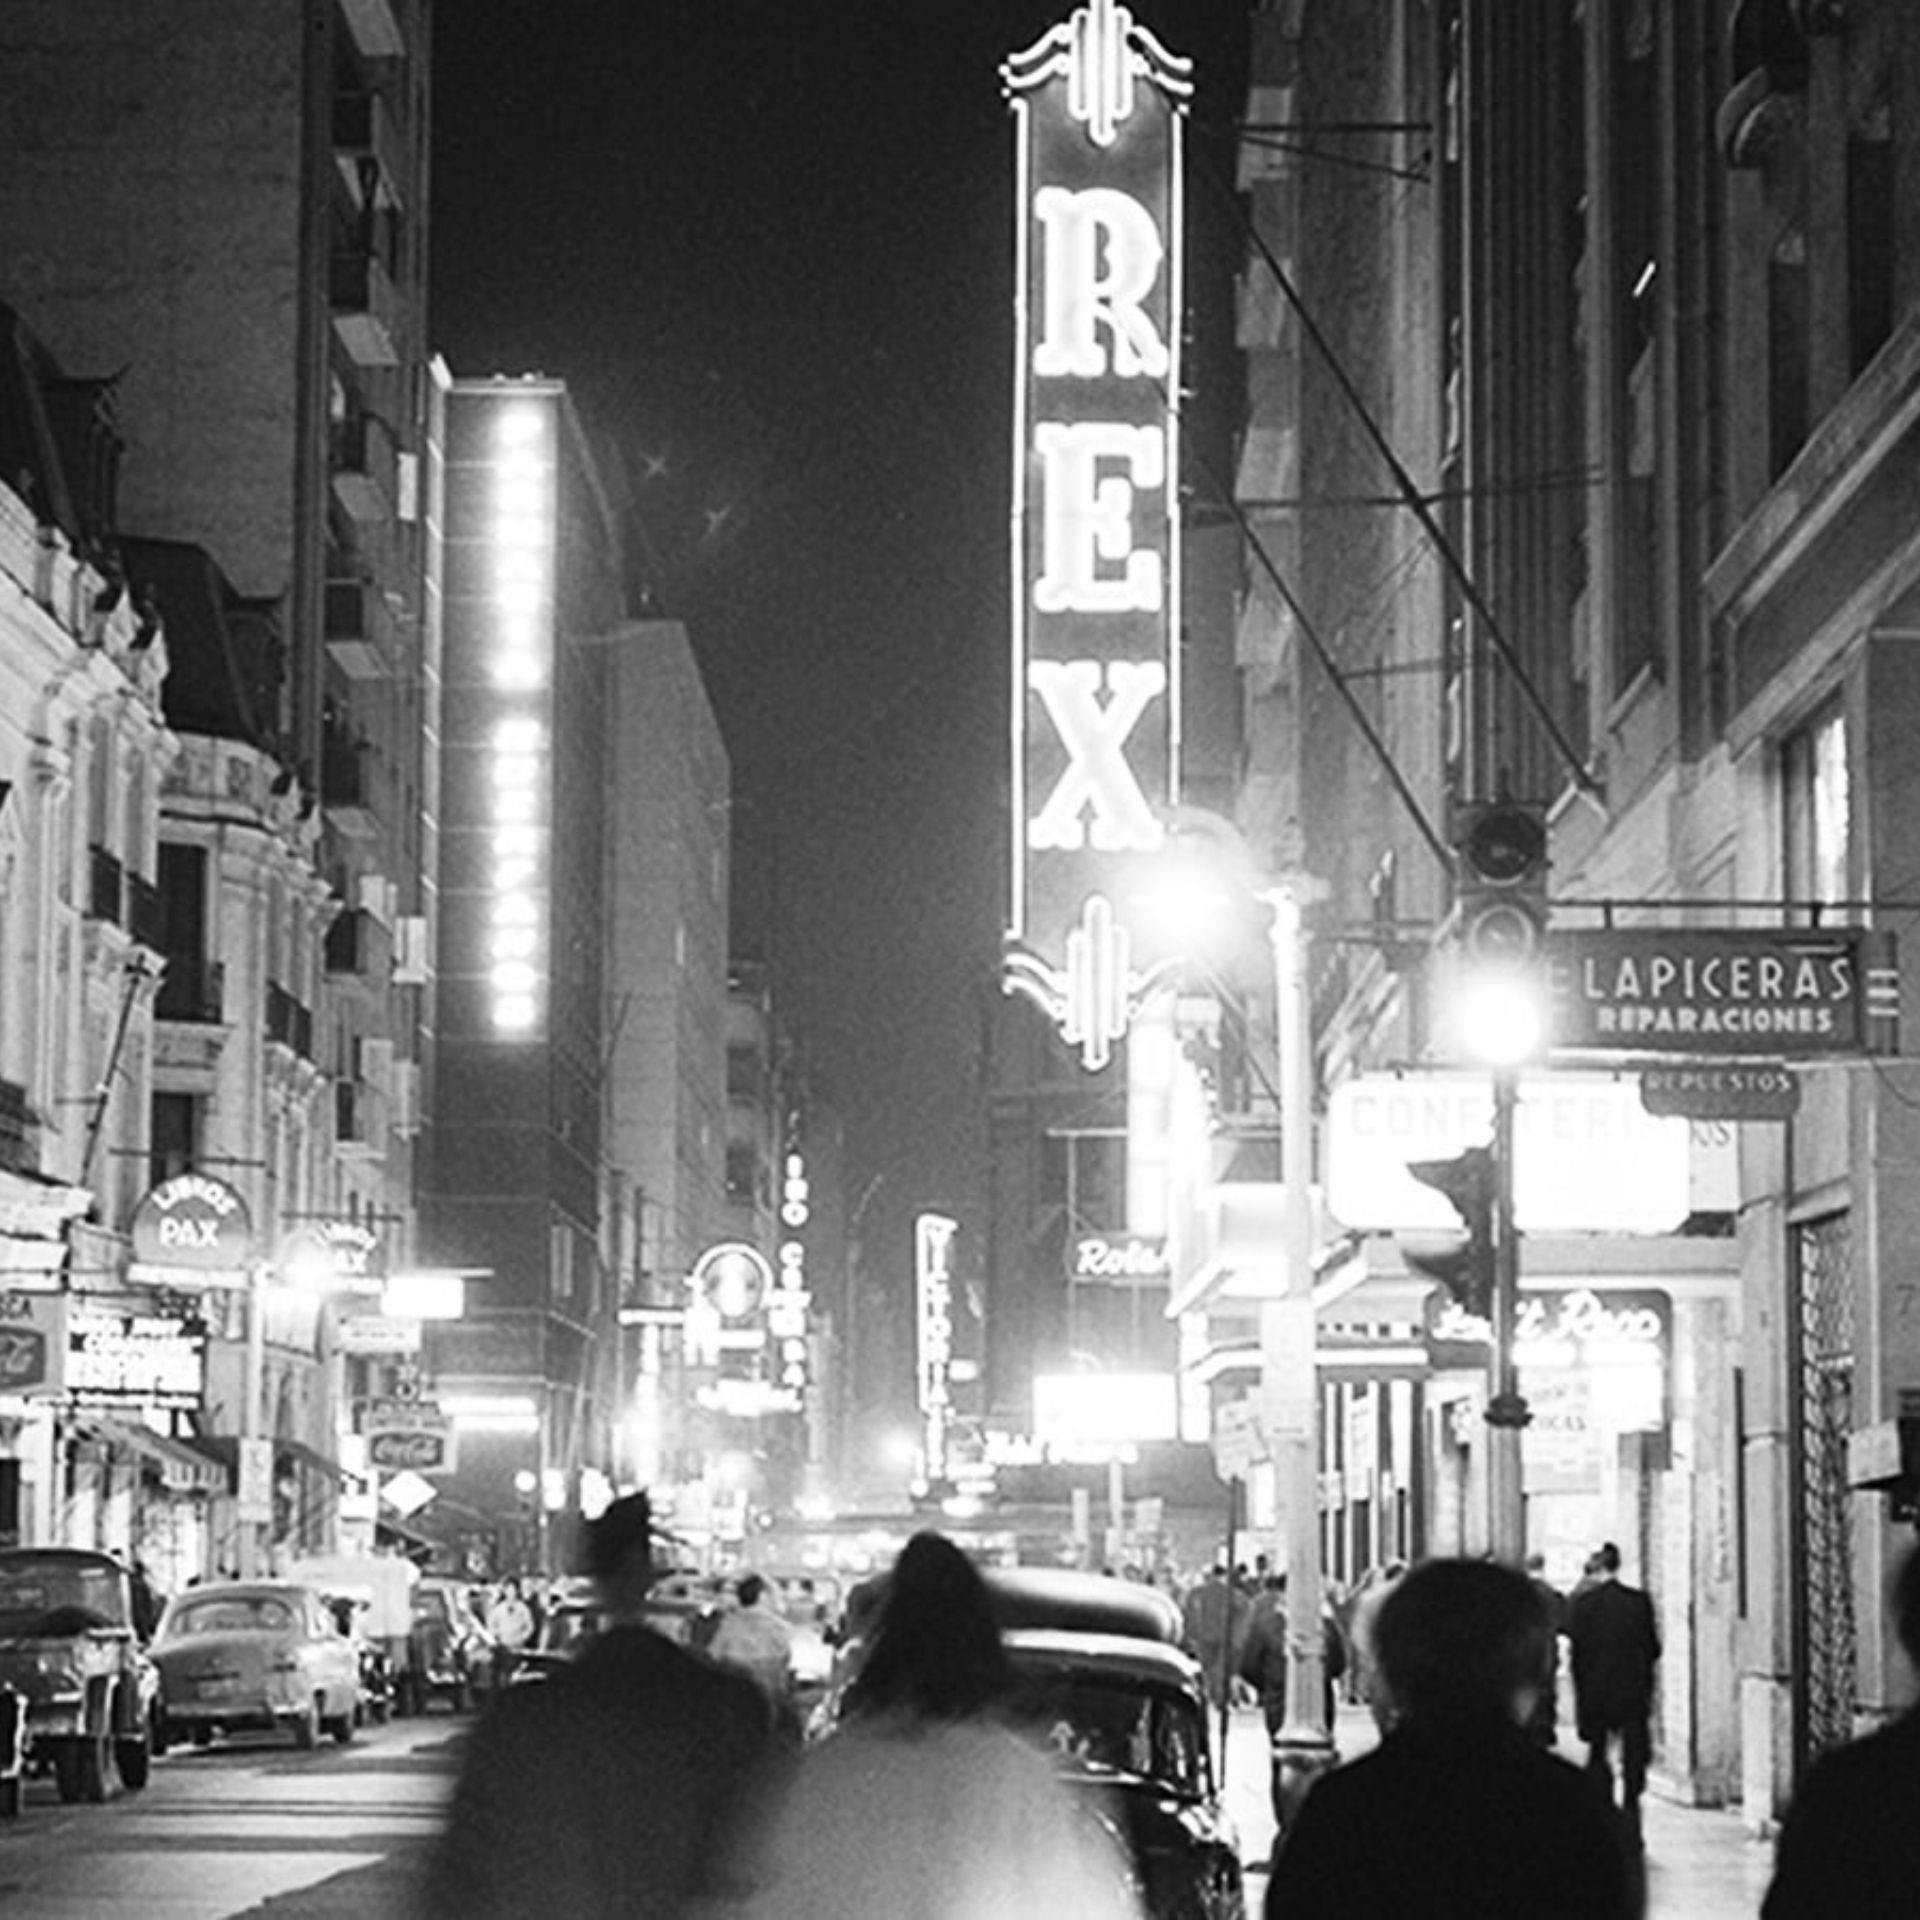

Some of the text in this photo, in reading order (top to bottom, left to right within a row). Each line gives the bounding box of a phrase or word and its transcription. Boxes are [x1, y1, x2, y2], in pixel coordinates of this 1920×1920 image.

[1029, 187, 1169, 850] REX
[1585, 956, 1850, 1000] LAPICERAS
[1596, 1006, 1833, 1033] REPARACIONES
[1647, 1070, 1792, 1093] REPUESTOS
[1352, 1096, 1672, 1140] CONFTERI
[159, 1216, 219, 1248] PAX
